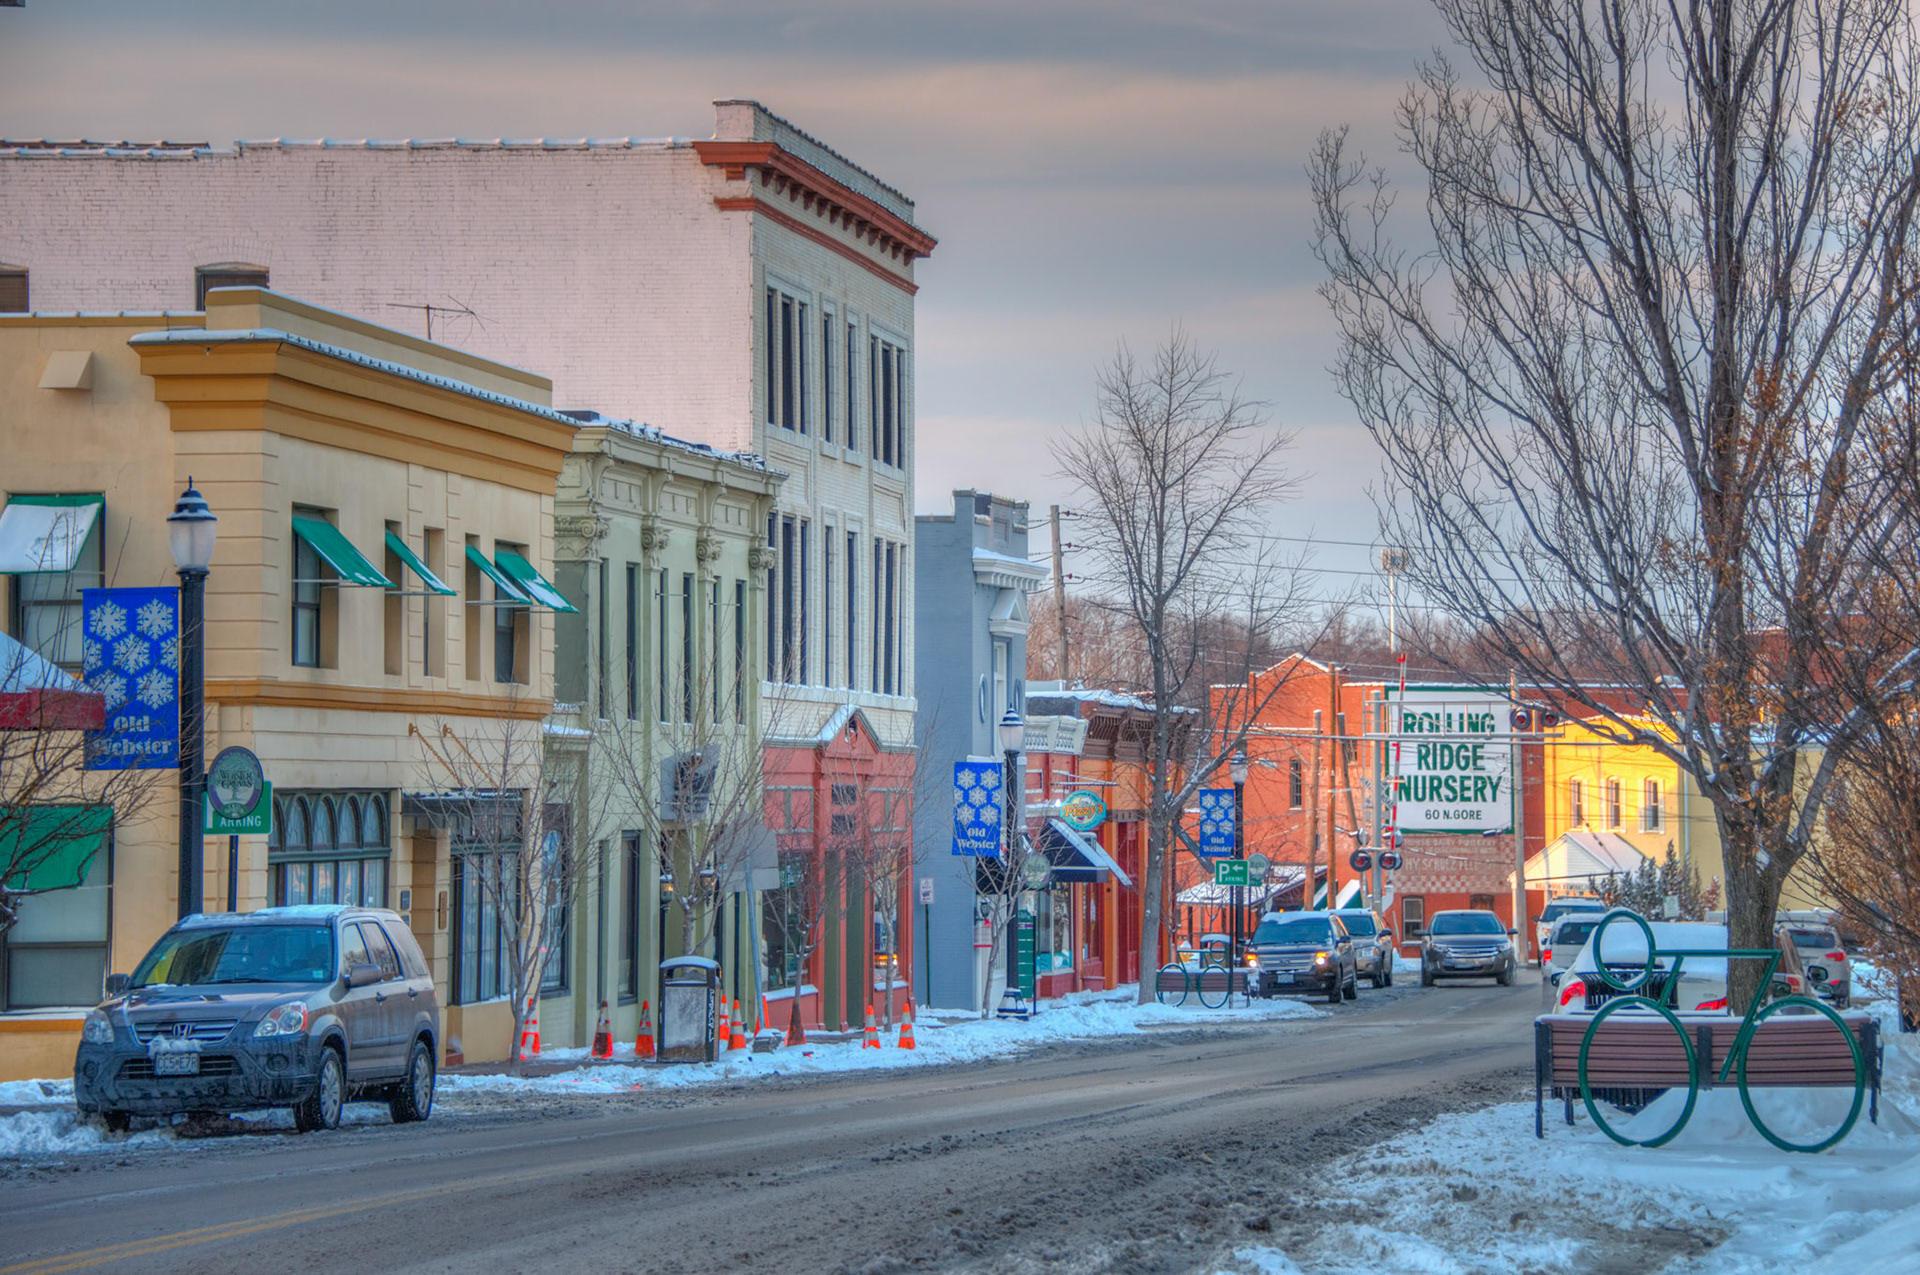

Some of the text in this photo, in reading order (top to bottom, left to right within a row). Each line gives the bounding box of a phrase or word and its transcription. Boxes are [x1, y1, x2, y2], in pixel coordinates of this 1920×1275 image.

[113, 716, 150, 732] Old
[1403, 711, 1495, 738] ROLLING
[93, 739, 172, 755] Webster
[1417, 742, 1486, 770] RIDGE
[1398, 775, 1502, 802] NURSERY
[1062, 802, 1104, 818] Fizzy's
[1425, 809, 1439, 820] 60
[967, 827, 986, 837] Old
[957, 839, 996, 849] Webster
